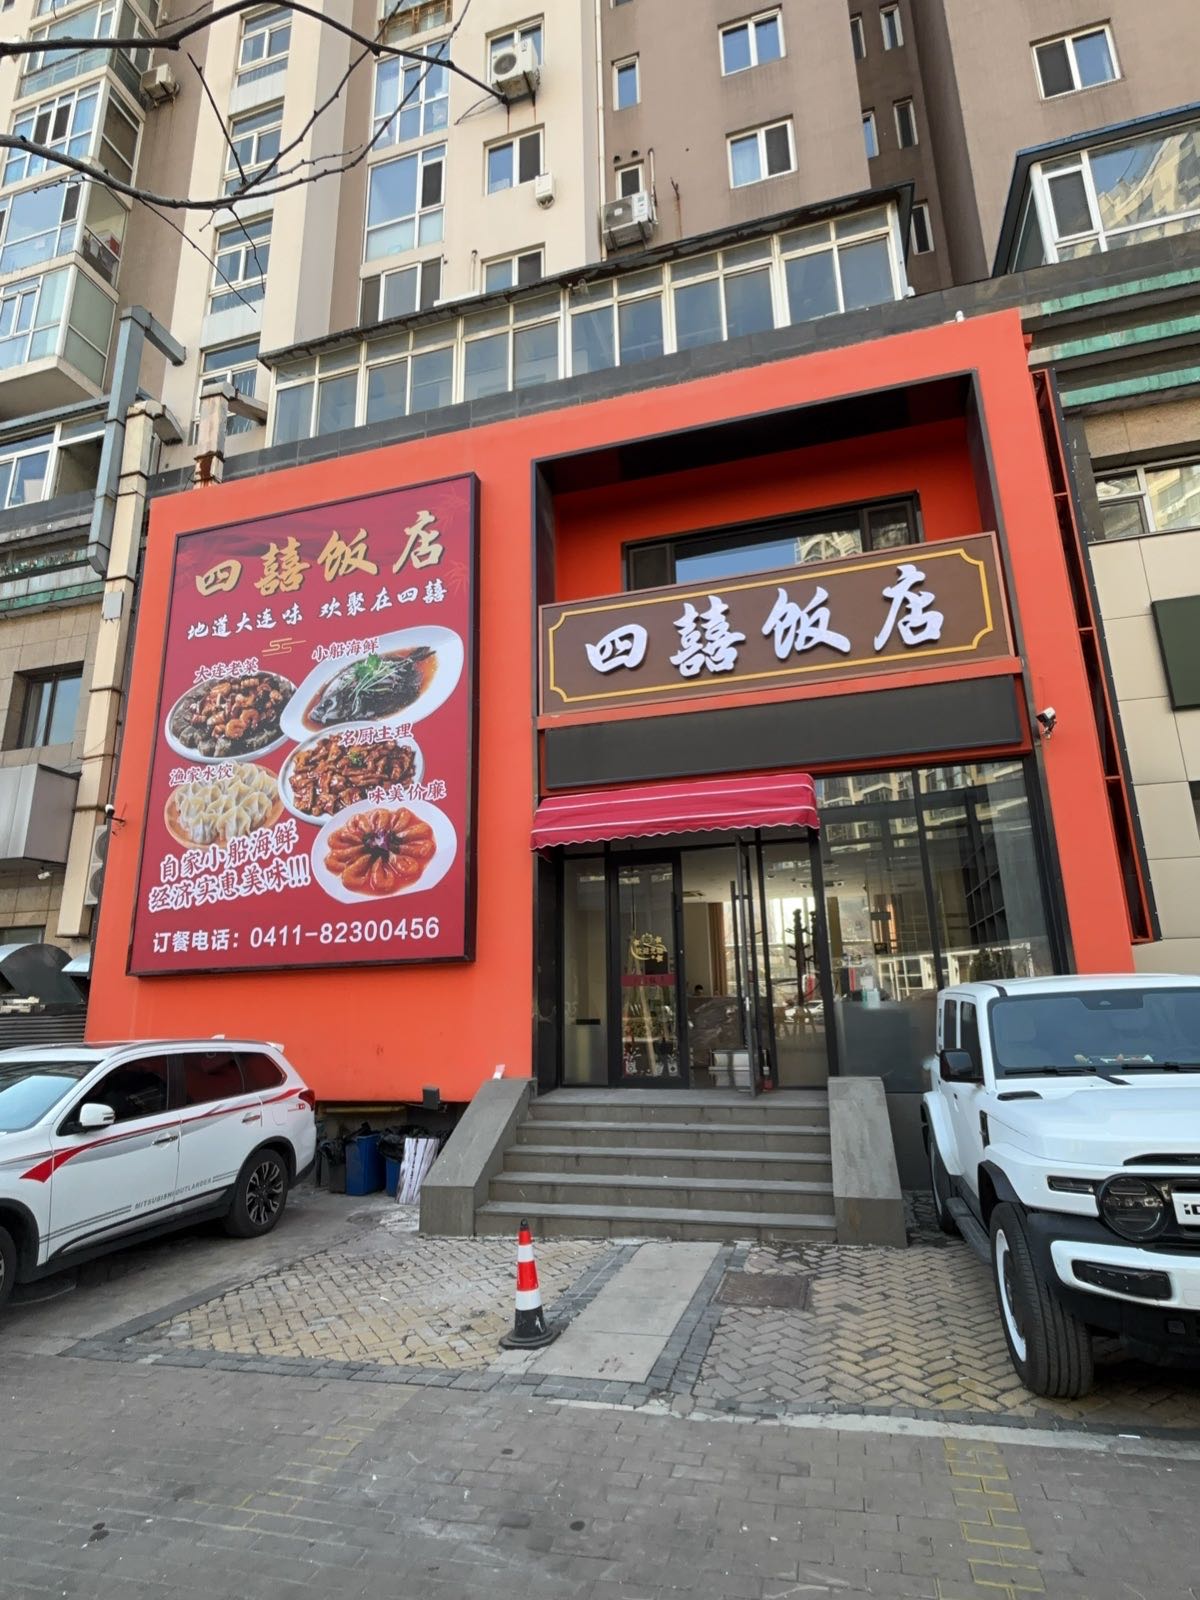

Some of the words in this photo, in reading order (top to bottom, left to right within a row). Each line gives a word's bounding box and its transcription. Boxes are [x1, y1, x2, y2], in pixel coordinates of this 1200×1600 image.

[187, 602, 303, 640] 地道大连味
[312, 637, 380, 662] 小船海鲜
[193, 656, 260, 684] 大连老菜
[337, 722, 414, 747] 名厨主理
[169, 763, 234, 787] 渔家水饺
[367, 779, 447, 804] 味美价廉
[160, 819, 299, 883] 自家小船海鲜
[250, 916, 440, 948] 0411-82300456
